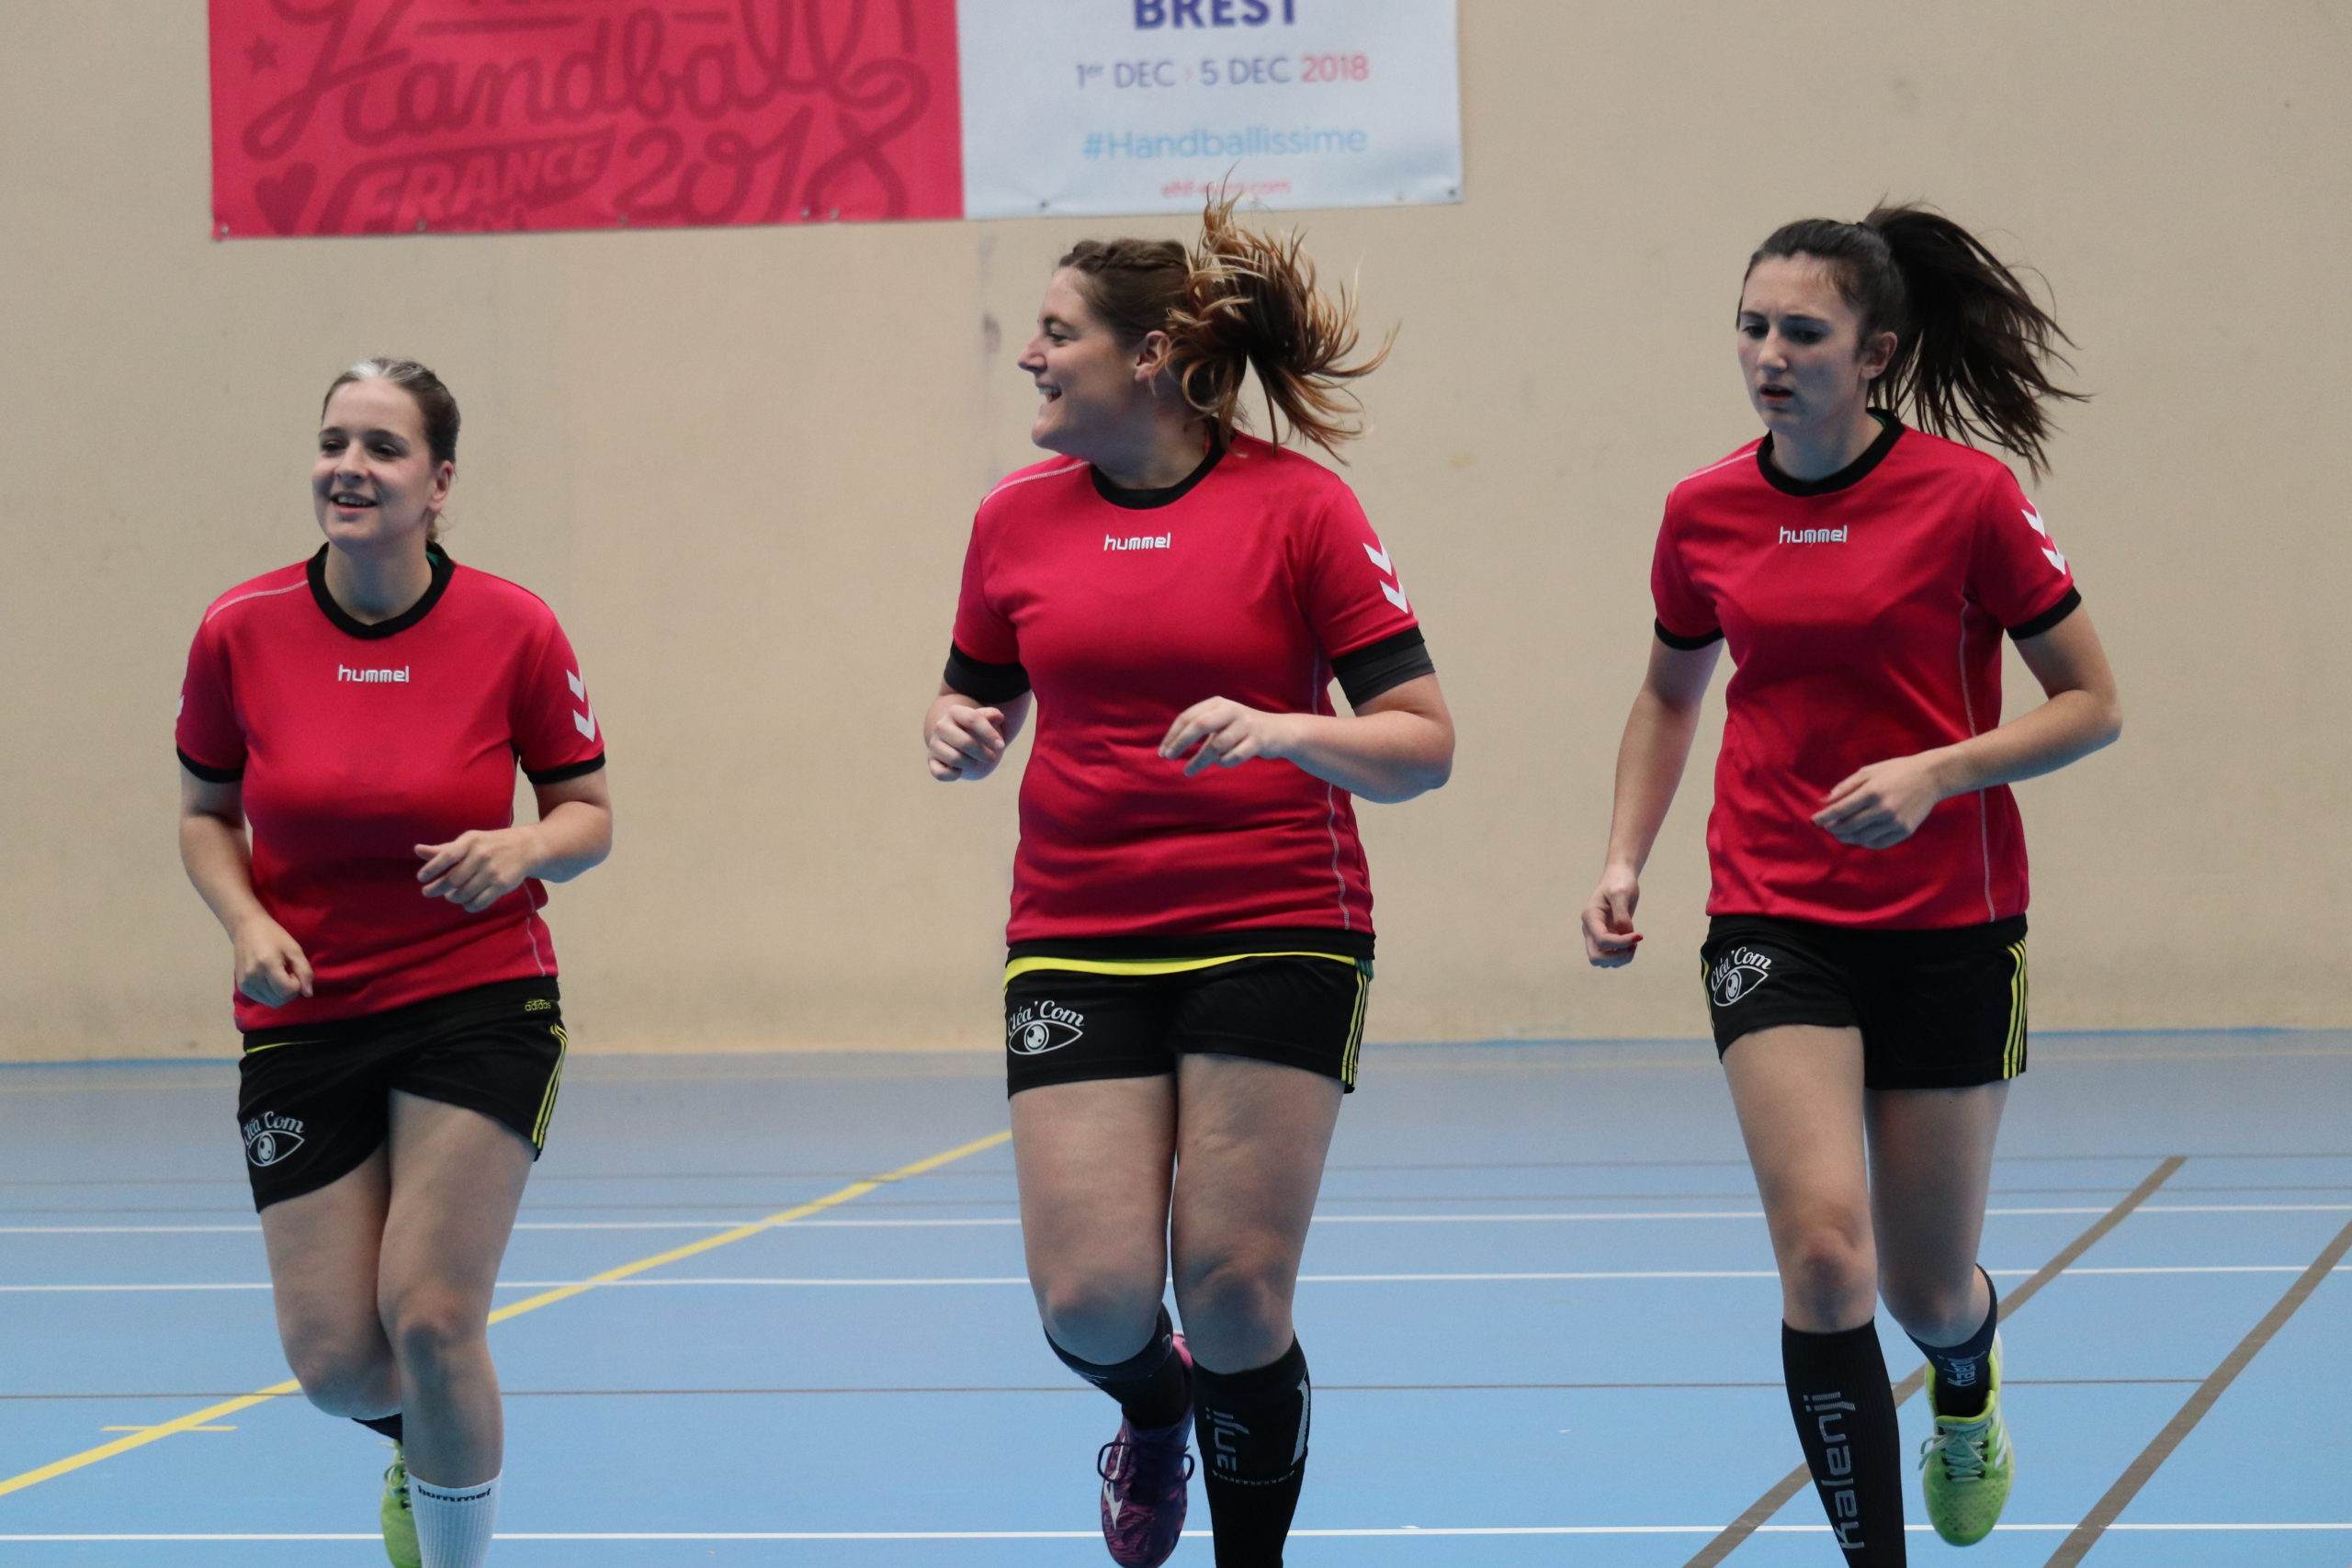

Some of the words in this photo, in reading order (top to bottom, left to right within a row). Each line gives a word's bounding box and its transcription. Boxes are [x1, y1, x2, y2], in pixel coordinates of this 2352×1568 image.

[1134, 0, 1295, 29] BREST
[1114, 61, 1175, 88] DEC
[1200, 59, 1219, 85] 5
[1228, 56, 1291, 85] DEC
[1301, 54, 1369, 83] 2018
[1080, 125, 1368, 159] #Handballissime
[341, 141, 601, 232] FRANCE
[1103, 532, 1171, 551] hummel
[1779, 525, 1848, 545] hummel
[338, 663, 410, 682] hummel
[1803, 1392, 1865, 1550] kalenji
[417, 1484, 492, 1503] hummel
